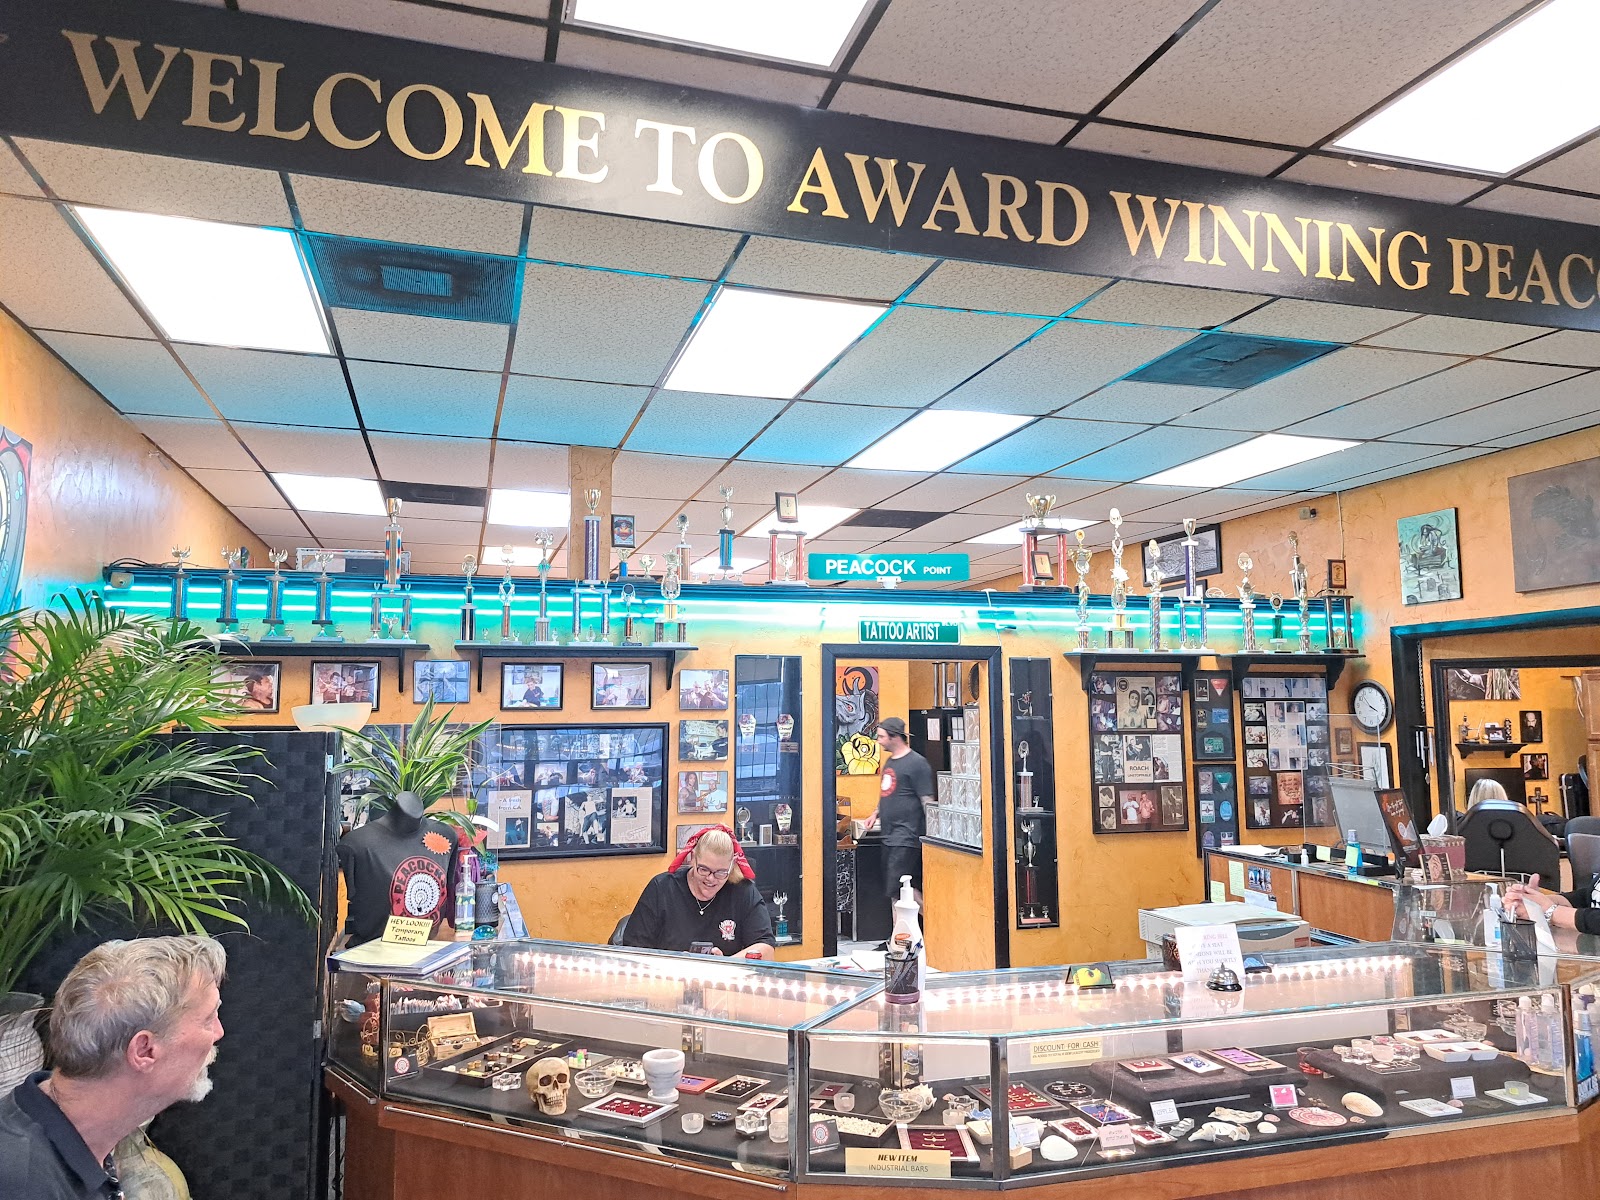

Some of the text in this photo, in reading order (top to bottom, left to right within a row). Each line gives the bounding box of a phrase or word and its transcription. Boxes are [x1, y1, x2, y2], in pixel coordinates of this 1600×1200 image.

[61, 29, 1600, 309] WELCOME TO AWARD WINNING PEAC
[825, 559, 952, 575] PEACOCK POINT
[864, 622, 941, 640] TATTOO ARTIST
[392, 926, 424, 936] Temporary
[1034, 1043, 1064, 1052] DISCOUNT
[878, 1154, 897, 1162] NEW
[868, 1164, 909, 1172] INDUSTRIAL
